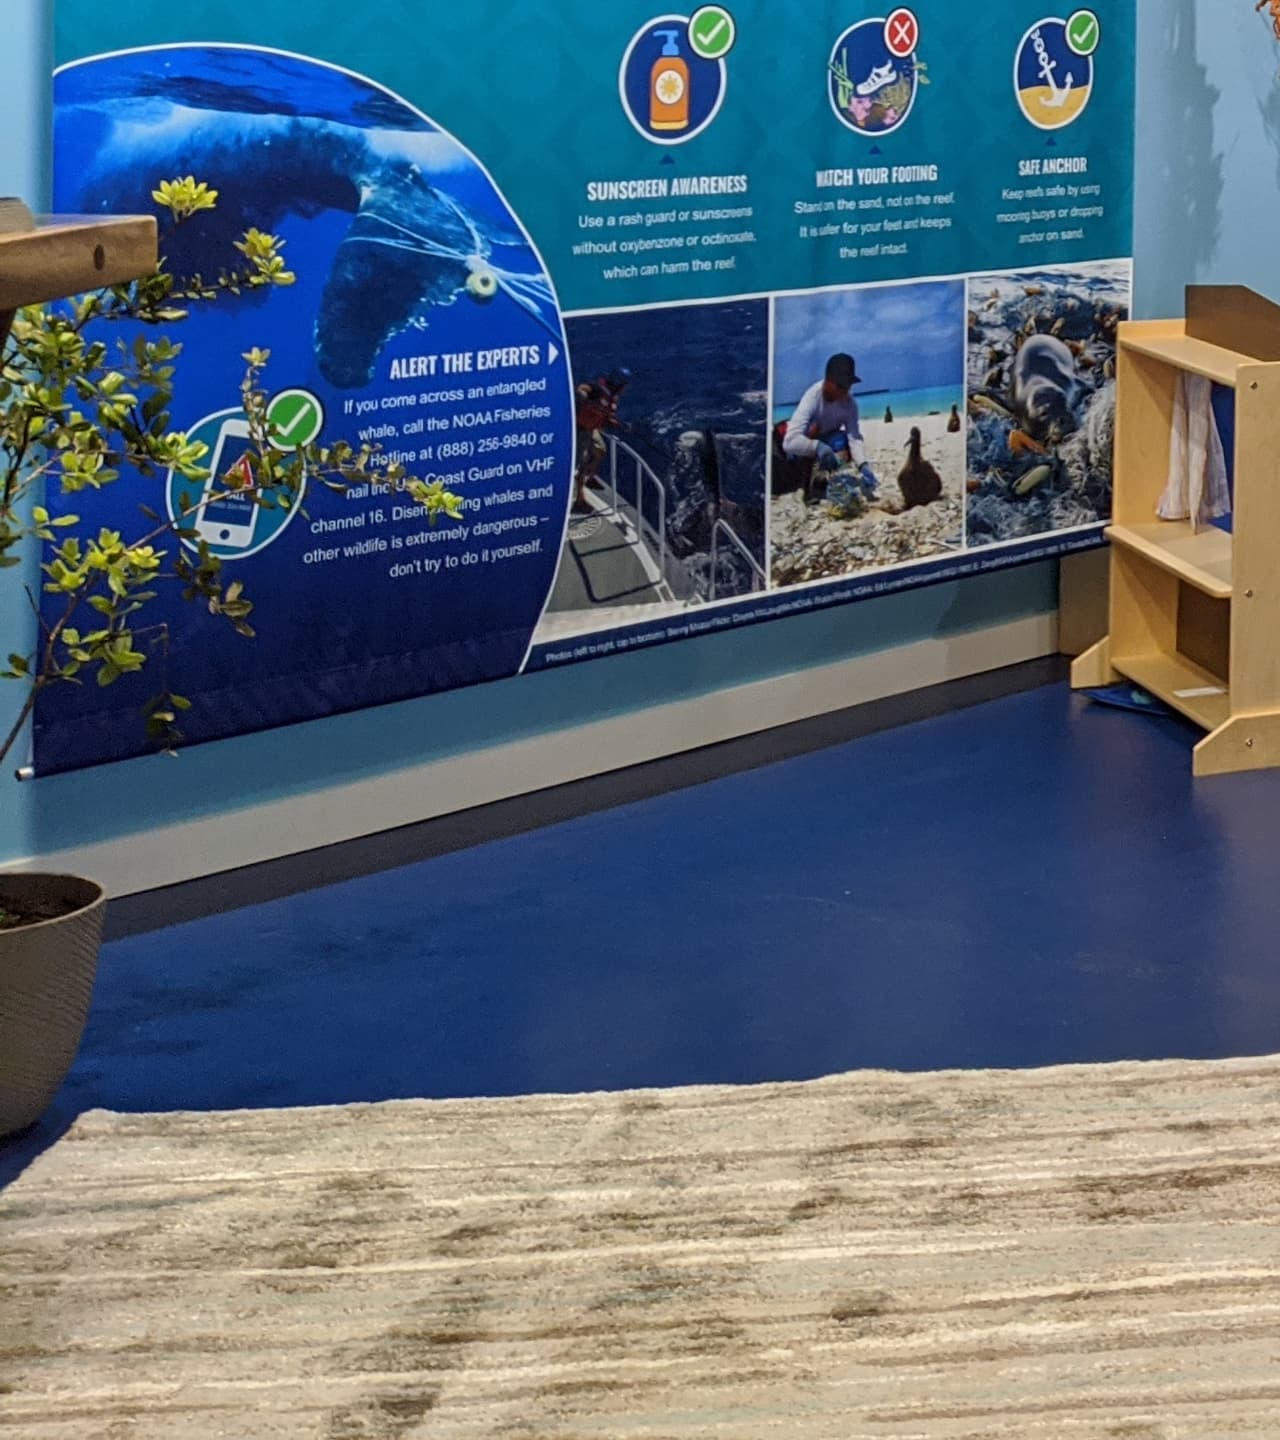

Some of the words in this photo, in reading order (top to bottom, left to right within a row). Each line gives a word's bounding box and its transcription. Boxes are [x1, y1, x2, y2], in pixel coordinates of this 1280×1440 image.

[1019, 159, 1040, 176] SAFE
[1043, 157, 1087, 174] ANCHOR
[588, 179, 667, 201] SUNSCREEN
[671, 175, 747, 196] AWARENESS
[390, 355, 437, 379] ALERT
[442, 352, 472, 374] THE
[478, 345, 539, 371] EXPERTS
[345, 399, 353, 414] If
[356, 400, 378, 416] you
[381, 394, 416, 409] come
[420, 389, 464, 404] across
[468, 387, 483, 399] an
[487, 377, 546, 397] entangled
[358, 423, 398, 445] whale,
[403, 419, 423, 435] call
[428, 417, 449, 431] the
[453, 411, 492, 428] NOAA
[495, 405, 550, 422] Fisheries
[370, 450, 416, 466] Hotline
[420, 446, 432, 460] at
[437, 441, 474, 461] (888)
[541, 433, 553, 444] or
[303, 548, 339, 564] other
[344, 537, 387, 558] wildlife
[392, 536, 402, 549] is
[406, 525, 469, 546] extremely
[473, 515, 537, 536] dangerous
[389, 560, 420, 578] don't
[425, 558, 441, 574] try
[446, 555, 458, 568] to
[462, 551, 478, 565] do
[482, 549, 488, 562] it
[492, 538, 542, 563] yourself.
